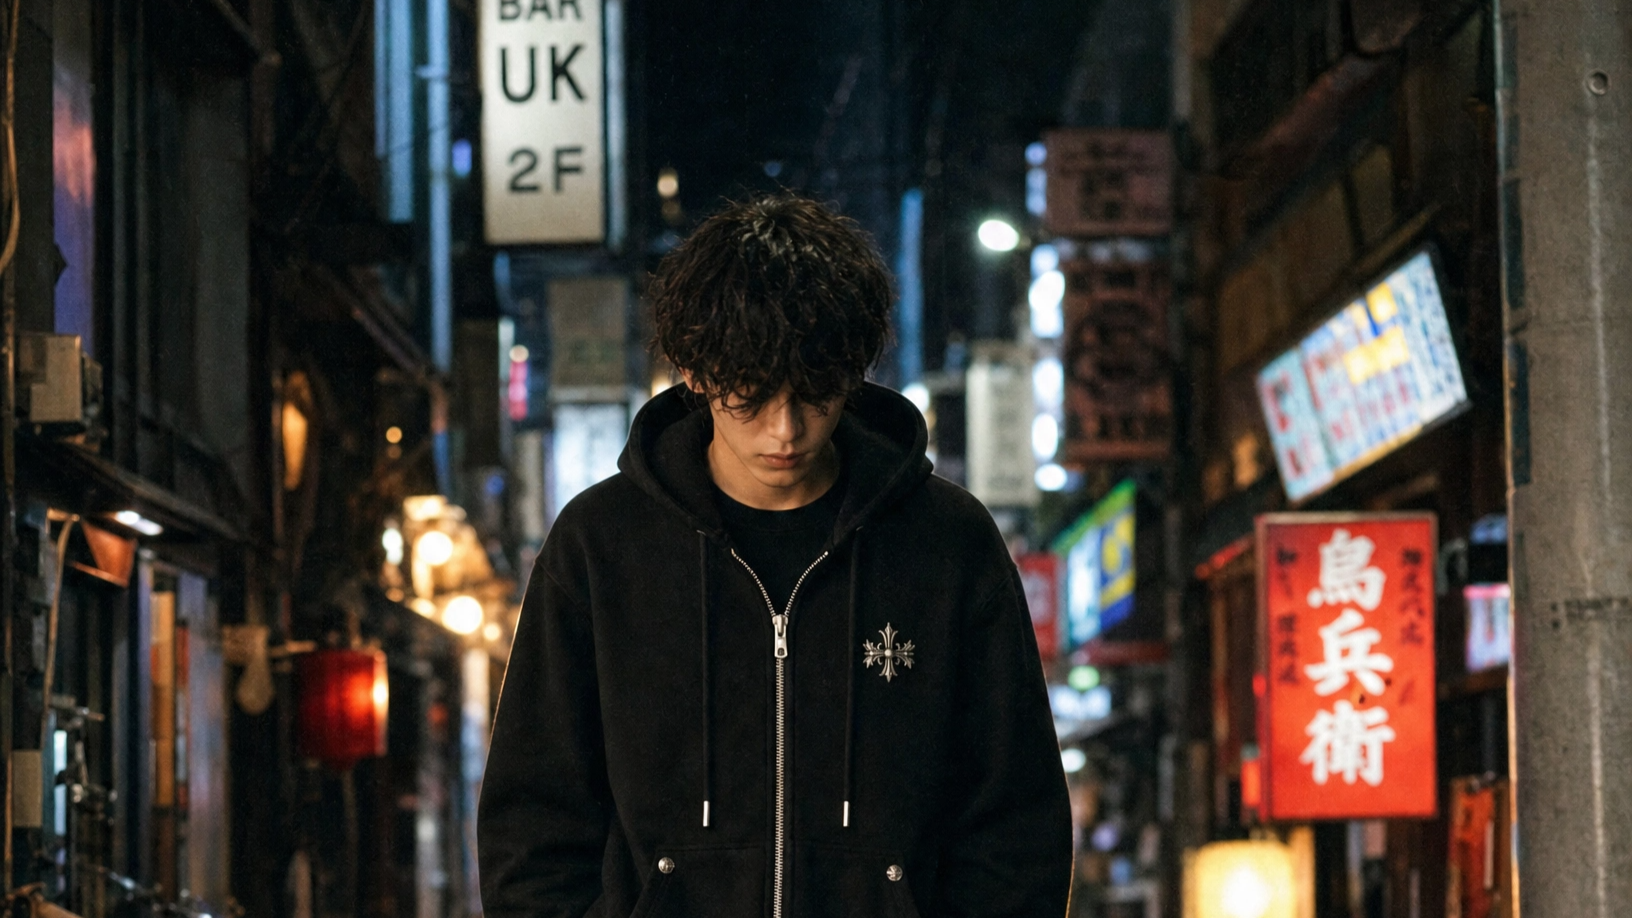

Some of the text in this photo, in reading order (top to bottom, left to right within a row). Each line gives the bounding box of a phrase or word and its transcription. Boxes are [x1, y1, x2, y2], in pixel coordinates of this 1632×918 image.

[499, 0, 582, 20] BAR
[500, 42, 586, 103] UK
[508, 145, 585, 194] 2F
